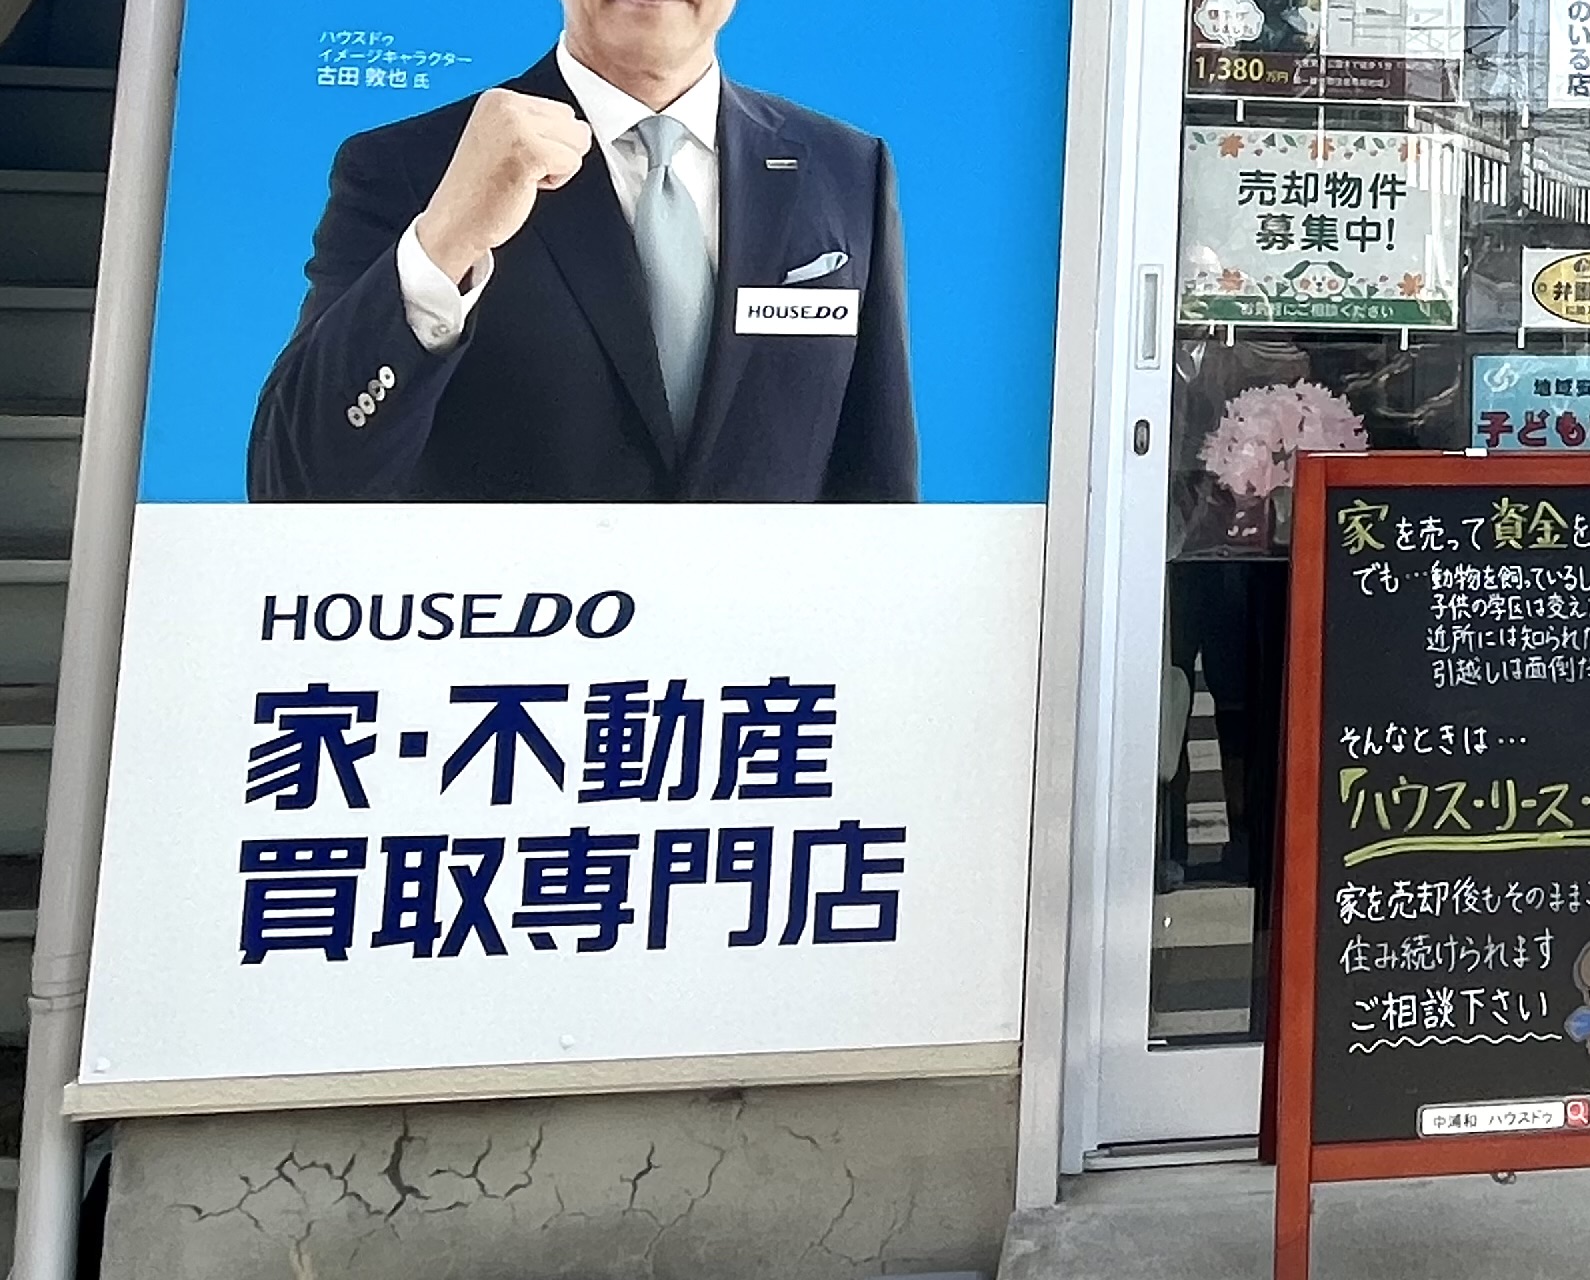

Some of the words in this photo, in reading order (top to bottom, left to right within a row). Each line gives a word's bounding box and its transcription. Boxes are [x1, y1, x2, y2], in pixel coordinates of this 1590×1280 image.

[318, 48, 473, 67] イメージキャラクター
[319, 30, 395, 47] ハウスドゥ
[317, 65, 360, 87] 古田
[365, 67, 407, 89] 敦也
[413, 73, 430, 90] 氏
[1237, 169, 1408, 211] 売却物件
[1255, 214, 1396, 254] 募集中!
[245, 676, 837, 811] 家・不動産
[239, 820, 907, 965] 買取専門店
[1339, 927, 1555, 975] 住み続けられます
[1351, 985, 1548, 1031] ご相談下さい
[1433, 1112, 1477, 1129] 中浦和
[1489, 1109, 1553, 1126] ハウスドゥ
